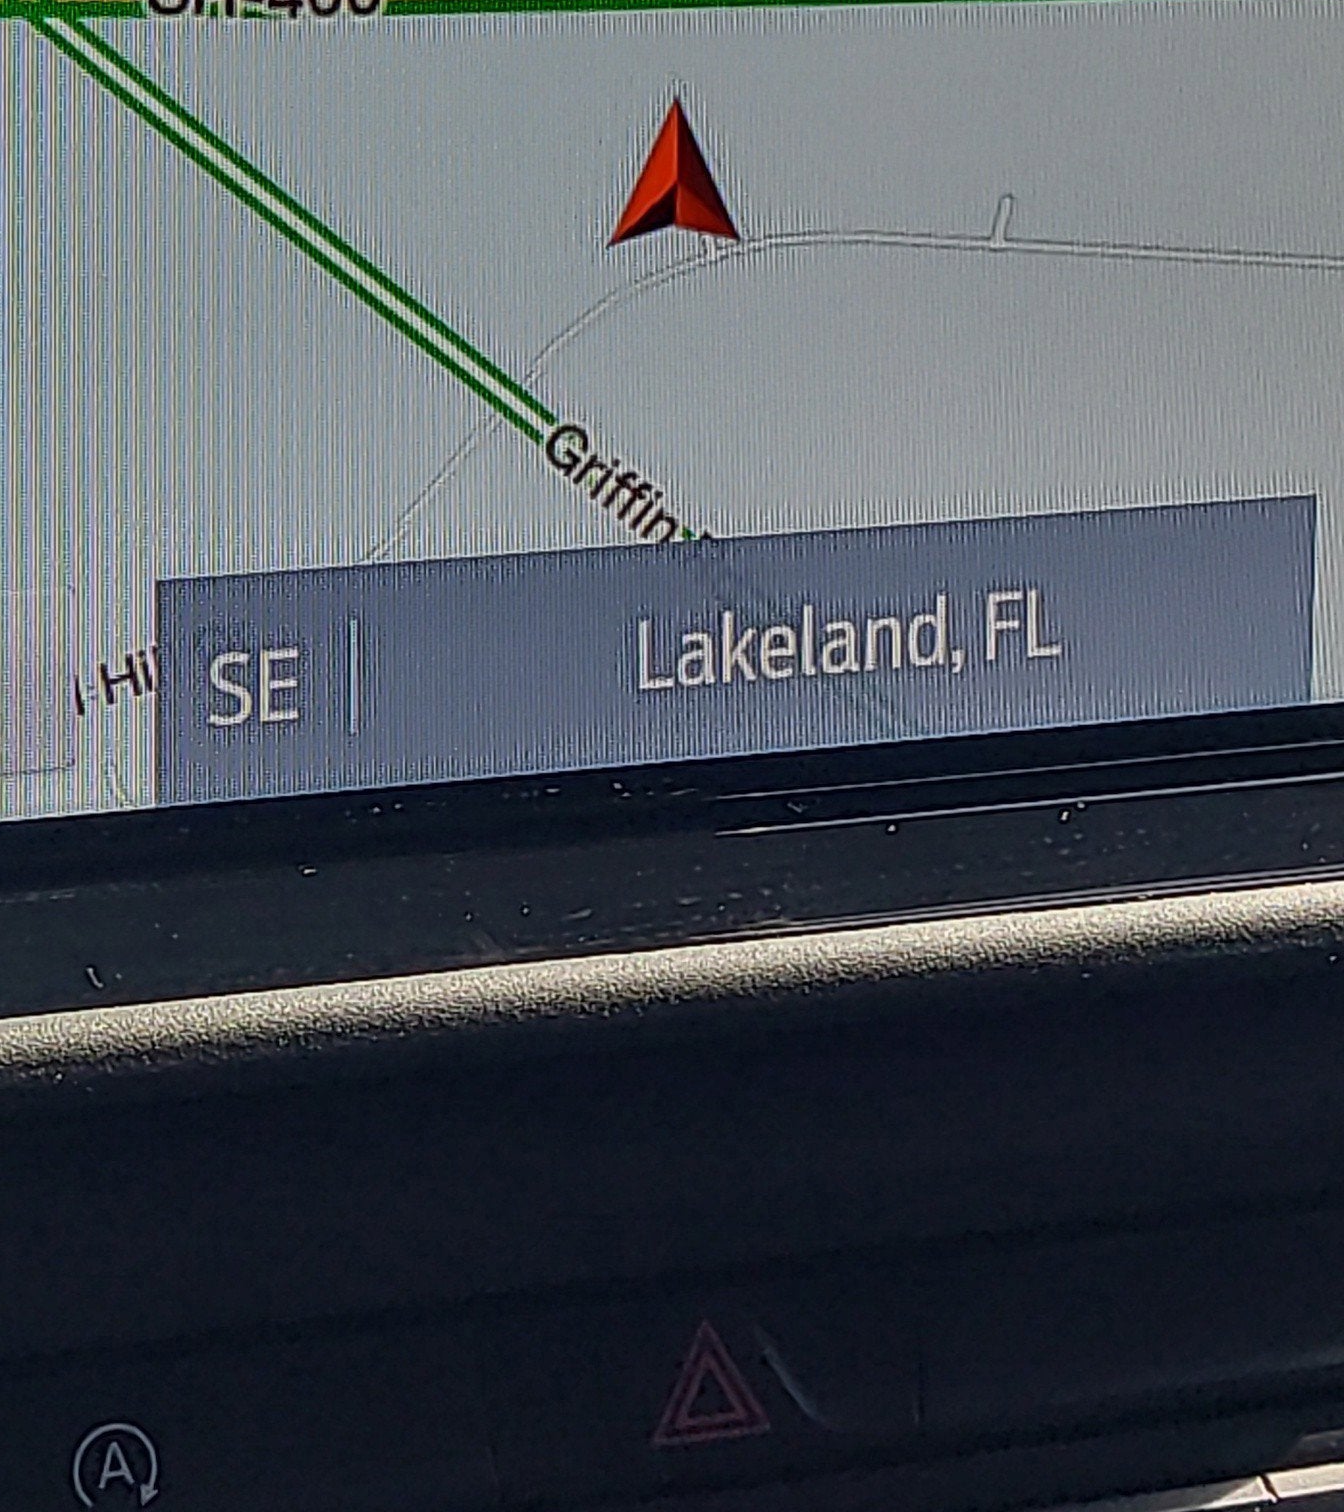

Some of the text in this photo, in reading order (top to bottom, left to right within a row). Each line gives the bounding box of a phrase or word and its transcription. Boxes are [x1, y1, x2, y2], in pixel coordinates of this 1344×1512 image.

[545, 424, 678, 543] Griffin
[206, 647, 299, 727] SE
[638, 589, 1063, 690] Lakeland, FL
